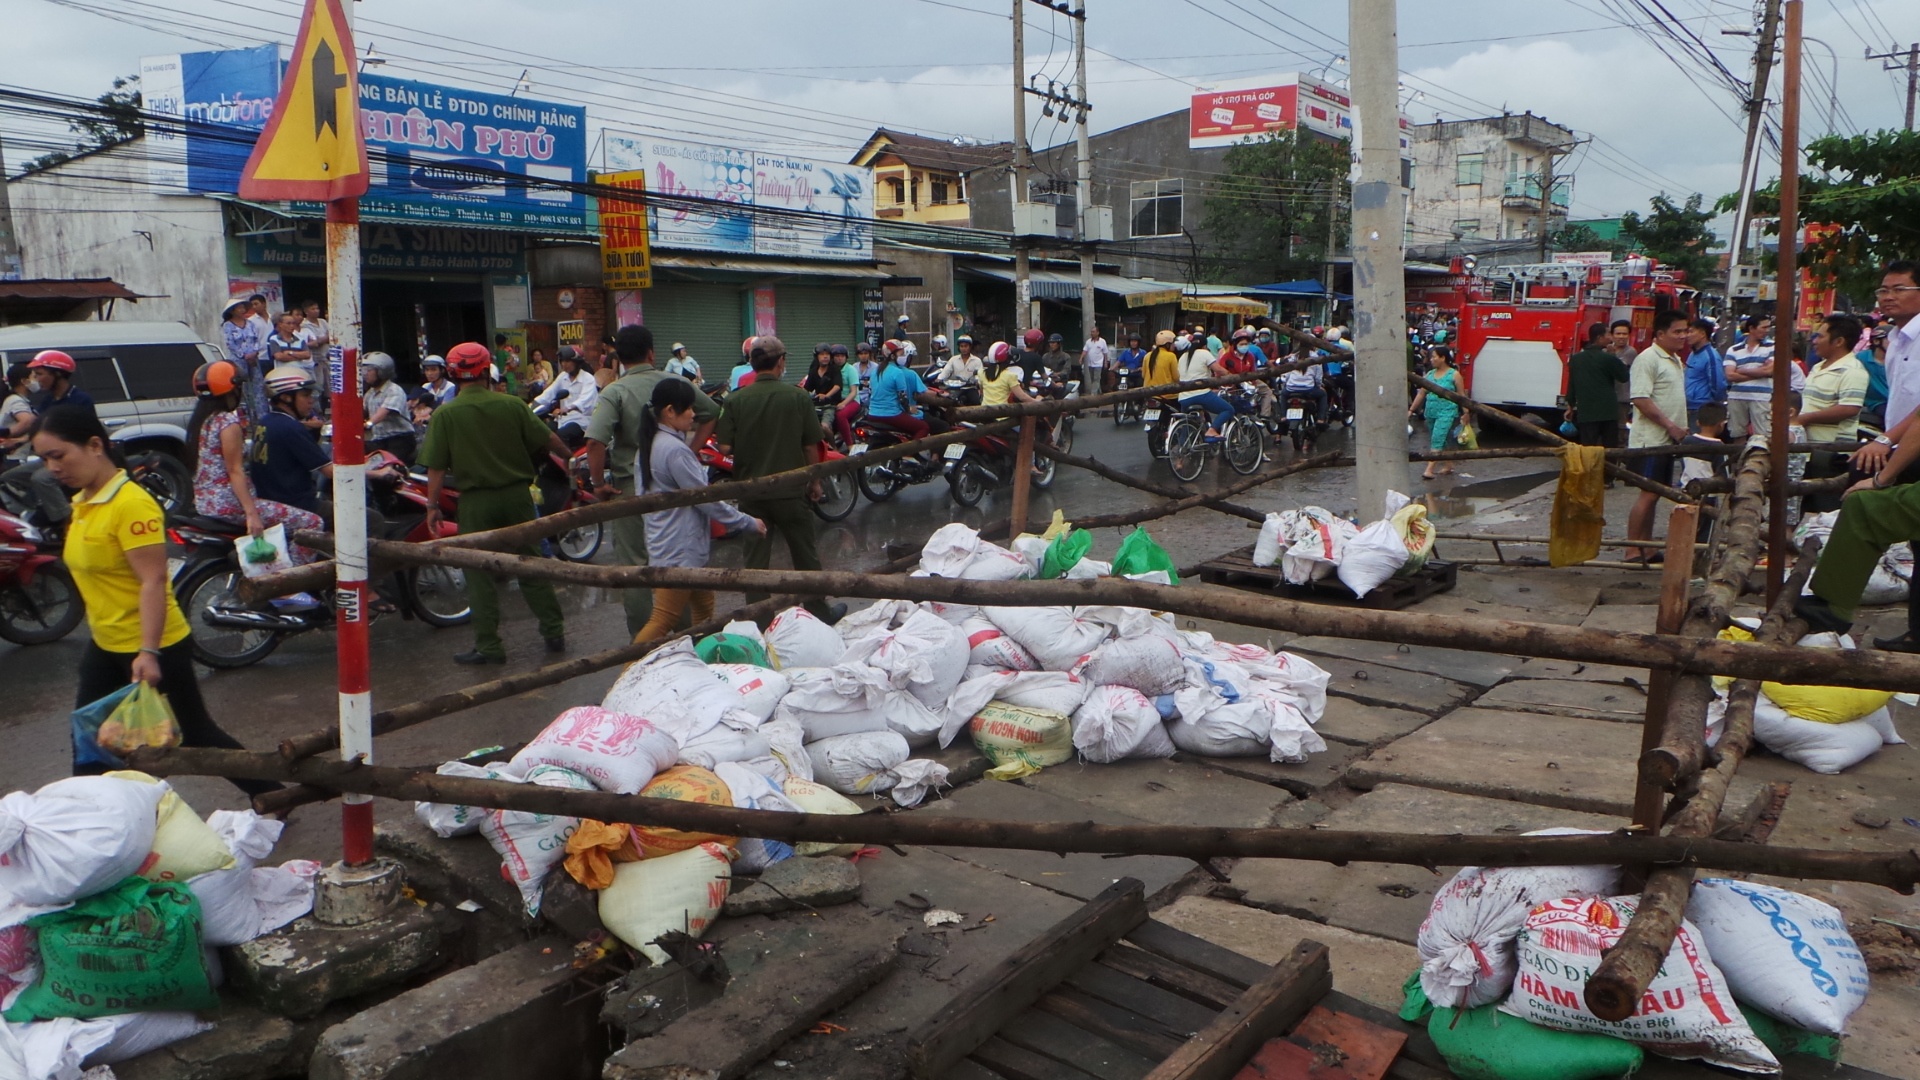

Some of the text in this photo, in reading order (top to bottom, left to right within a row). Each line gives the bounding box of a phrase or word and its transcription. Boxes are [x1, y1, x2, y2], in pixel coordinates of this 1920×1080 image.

[185, 91, 274, 124] mobifone
[358, 84, 381, 101] NG
[385, 85, 419, 106] BÁN
[424, 90, 443, 110] LẺ
[492, 103, 537, 124] CHÍNH
[1225, 95, 1241, 105] TRỢ
[1242, 92, 1257, 103] TRẢ
[1258, 91, 1276, 101] GÓP
[360, 106, 555, 161] HIÊN PHÚ
[424, 166, 494, 184] SAMSUNG
[431, 192, 489, 204] SAMSUNG
[431, 206, 451, 218] Giao
[254, 223, 519, 255] NOIA SAMSUNG
[604, 214, 643, 249] KEM
[263, 249, 295, 264] Mua
[299, 247, 327, 265] Bán
[368, 252, 402, 268] Chữa
[406, 255, 416, 268] &
[420, 252, 444, 268] Bảo
[988, 720, 1017, 740] NGON
[1015, 728, 1044, 745] THƠM
[569, 761, 583, 772] 25
[585, 764, 611, 780] KGS
[789, 787, 816, 796] KGS
[1523, 947, 1558, 976] GẠO
[1519, 969, 1582, 1011] HÀM
[1528, 998, 1559, 1015] Chất
[1561, 1009, 1608, 1030] Lượng
[1646, 1016, 1676, 1028] Biệt
[1529, 1011, 1573, 1028] Hương
[1576, 1022, 1618, 1037] Thơm
[1652, 1027, 1687, 1041] Ngát
